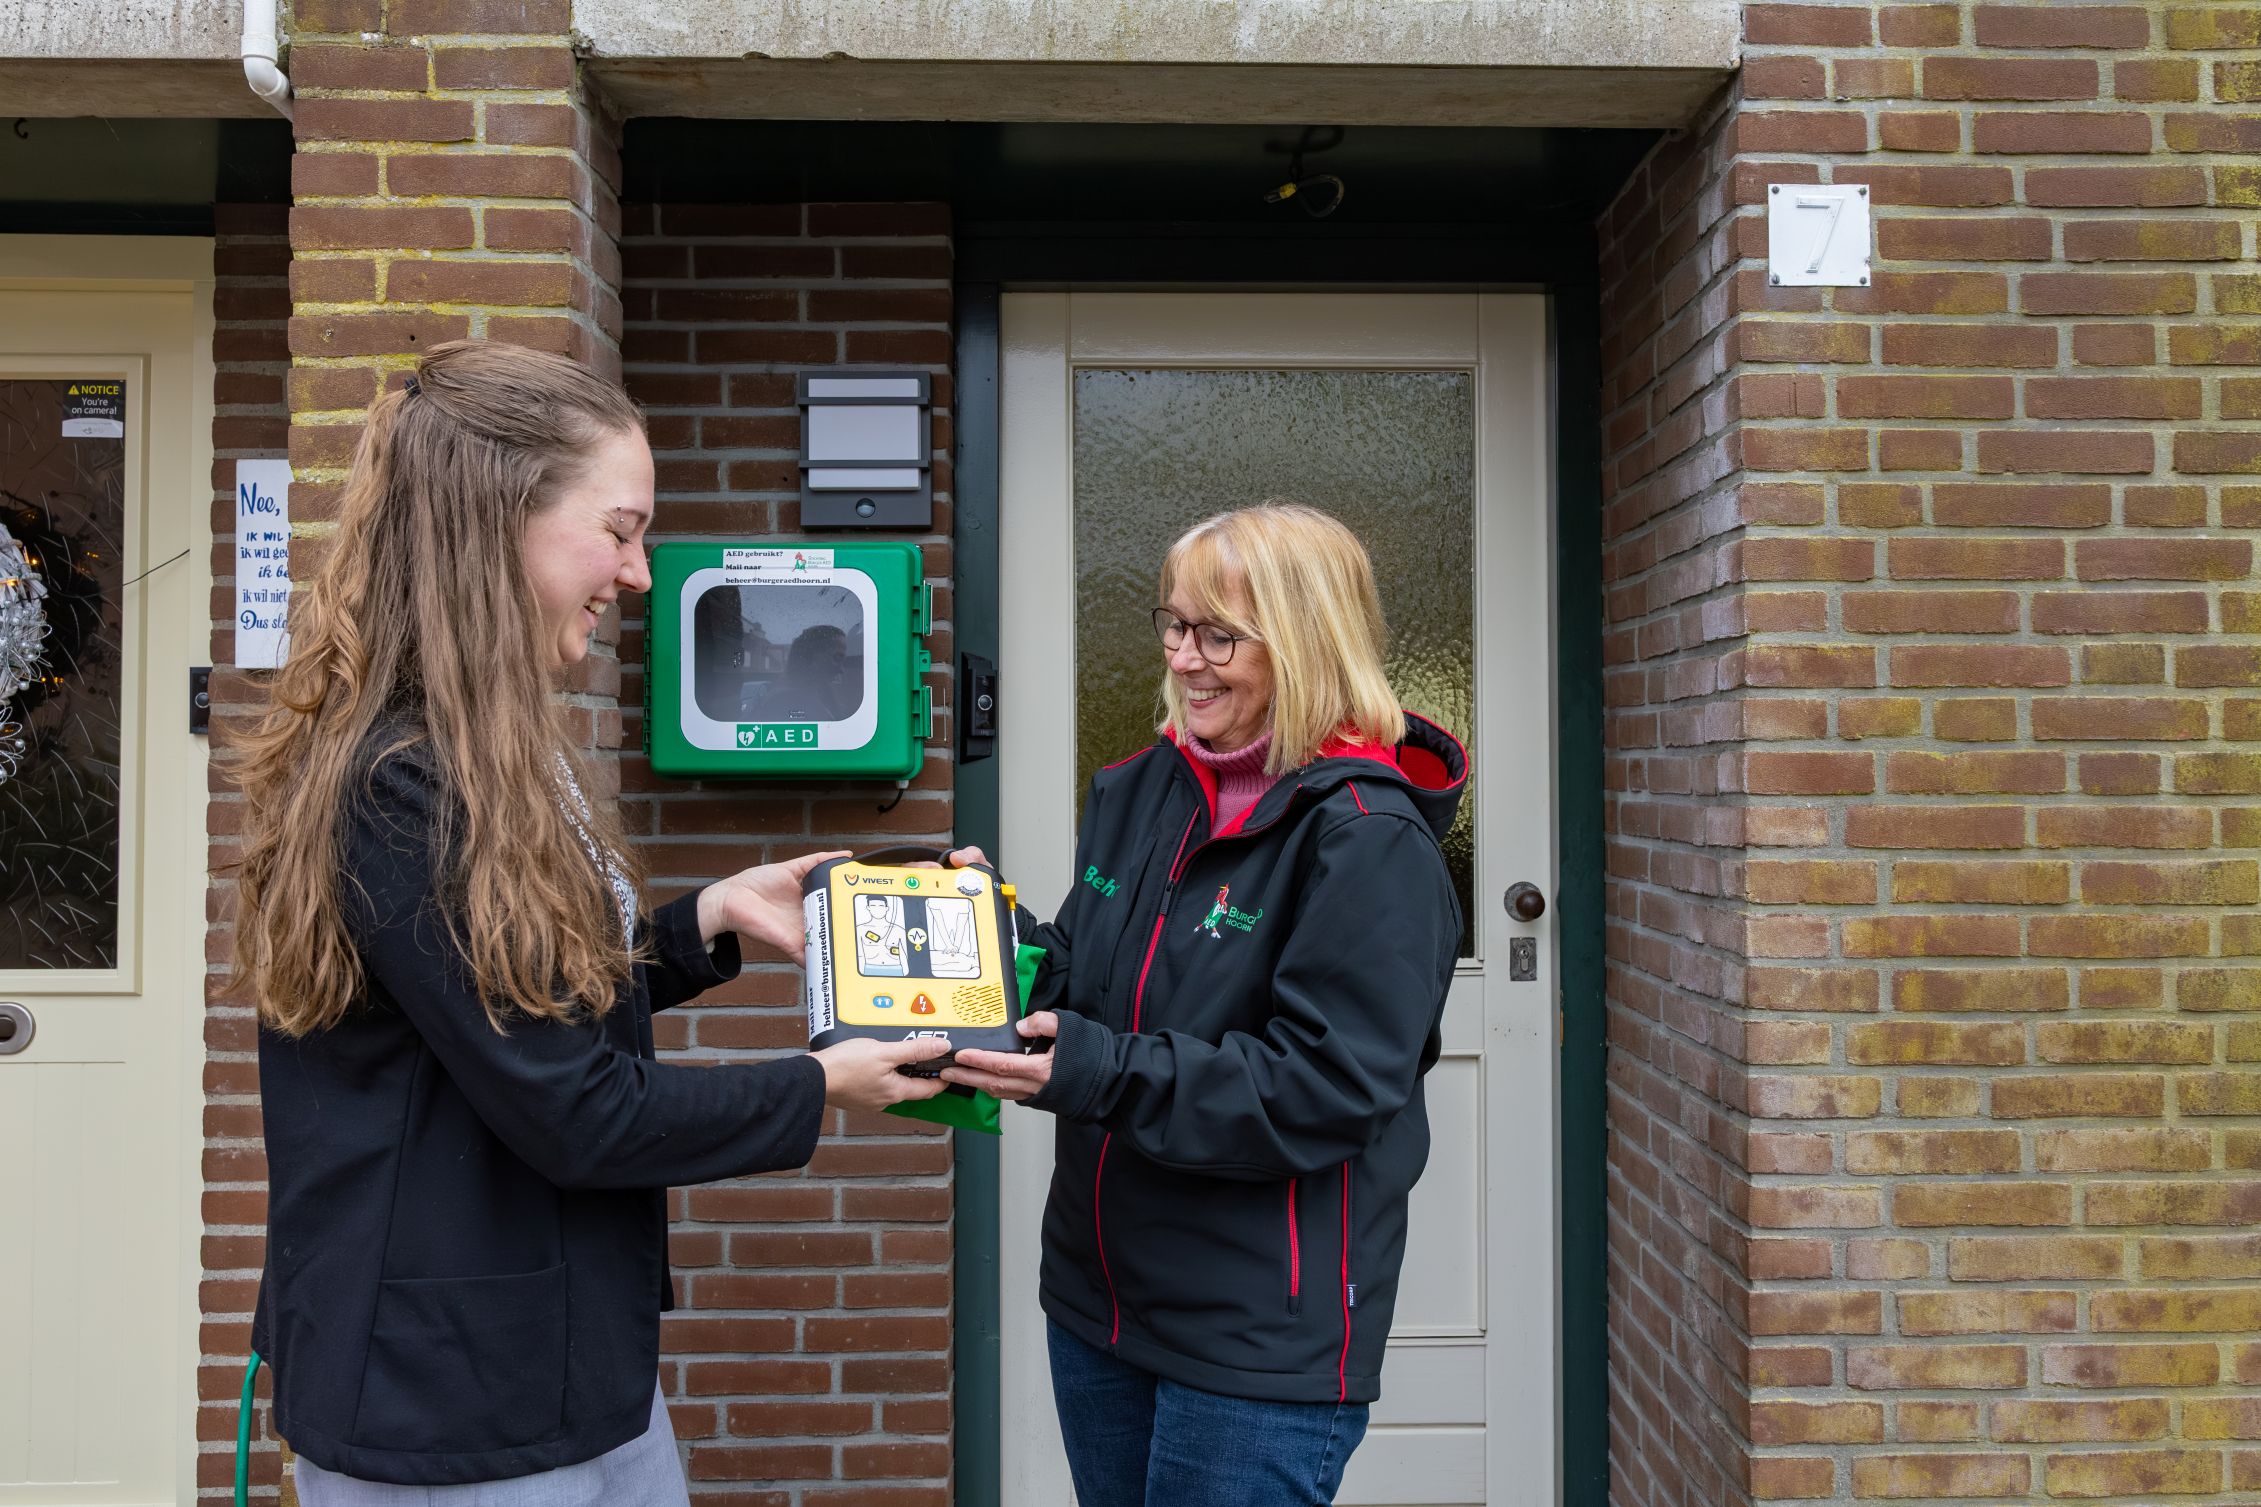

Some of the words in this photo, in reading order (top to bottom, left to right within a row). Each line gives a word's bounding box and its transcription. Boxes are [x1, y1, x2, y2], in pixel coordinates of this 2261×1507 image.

[1795, 195, 1845, 274] 7
[81, 385, 119, 395] NOTICE
[81, 397, 109, 406] You're
[240, 482, 281, 517] Nee,
[246, 531, 258, 542] IK
[263, 531, 284, 542] WIL
[240, 546, 252, 559] ik
[254, 547, 271, 559] wil
[745, 550, 784, 559] gebruikt?
[258, 565, 273, 578] ik
[725, 563, 743, 571] Mail
[725, 576, 831, 585] beheer@burgeraedhoorn.nl
[242, 588, 252, 603] ik
[253, 588, 268, 603] wil
[270, 588, 287, 603] niet
[240, 609, 269, 630] Dus
[271, 612, 288, 629] sla
[765, 729, 814, 743] AED
[862, 876, 895, 886] VIVEST
[816, 891, 832, 1028] beheer@burgeraedhoorn.nl
